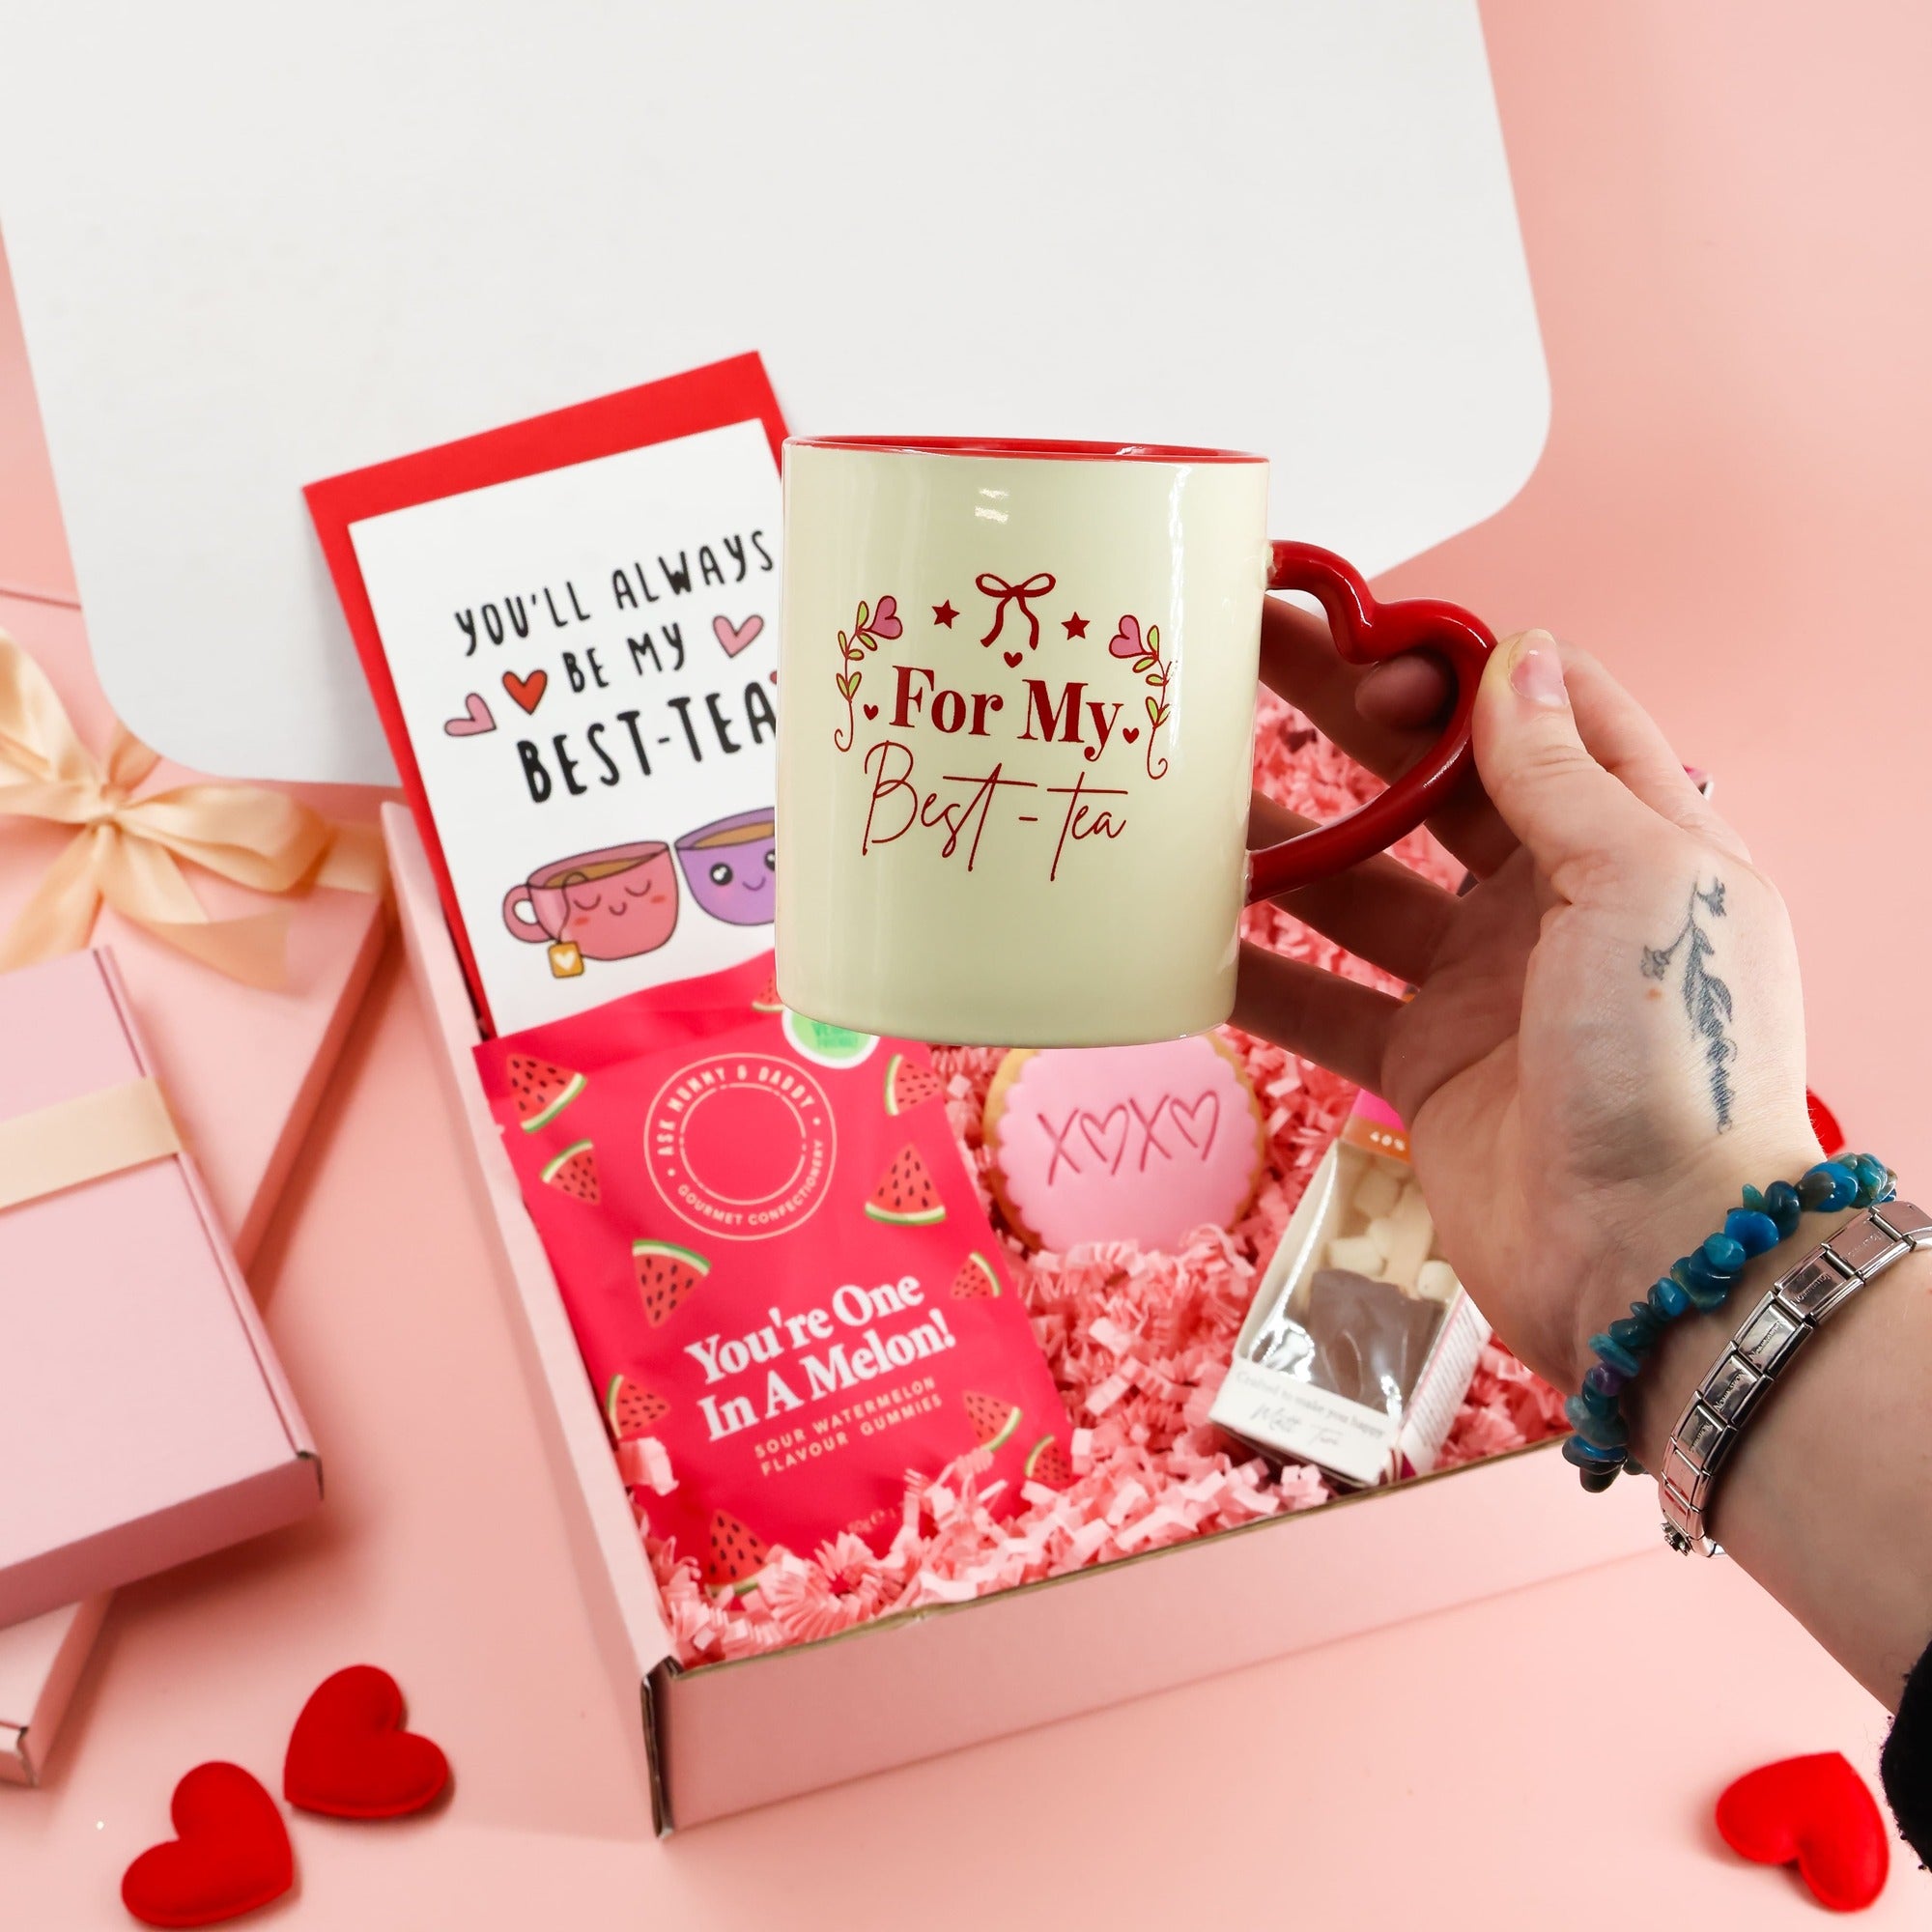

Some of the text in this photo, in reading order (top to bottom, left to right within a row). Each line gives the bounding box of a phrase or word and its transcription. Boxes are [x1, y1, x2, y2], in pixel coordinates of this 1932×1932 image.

[456, 529, 774, 656] YOU'LL ALWAYS
[562, 622, 686, 694] BE MY
[517, 681, 777, 804] BEST-TEA
[889, 665, 1124, 762] For My
[657, 1119, 675, 1156] ASK
[758, 1065, 815, 1108] DADDY
[677, 1139, 824, 1226] GOURMET CONFECTIONERY
[684, 1275, 925, 1385] You're One
[696, 1307, 956, 1442] In A Melon!
[754, 1376, 936, 1459] SOUR WATERMELON
[760, 1393, 943, 1477] FLAVOUR GUMMIES
